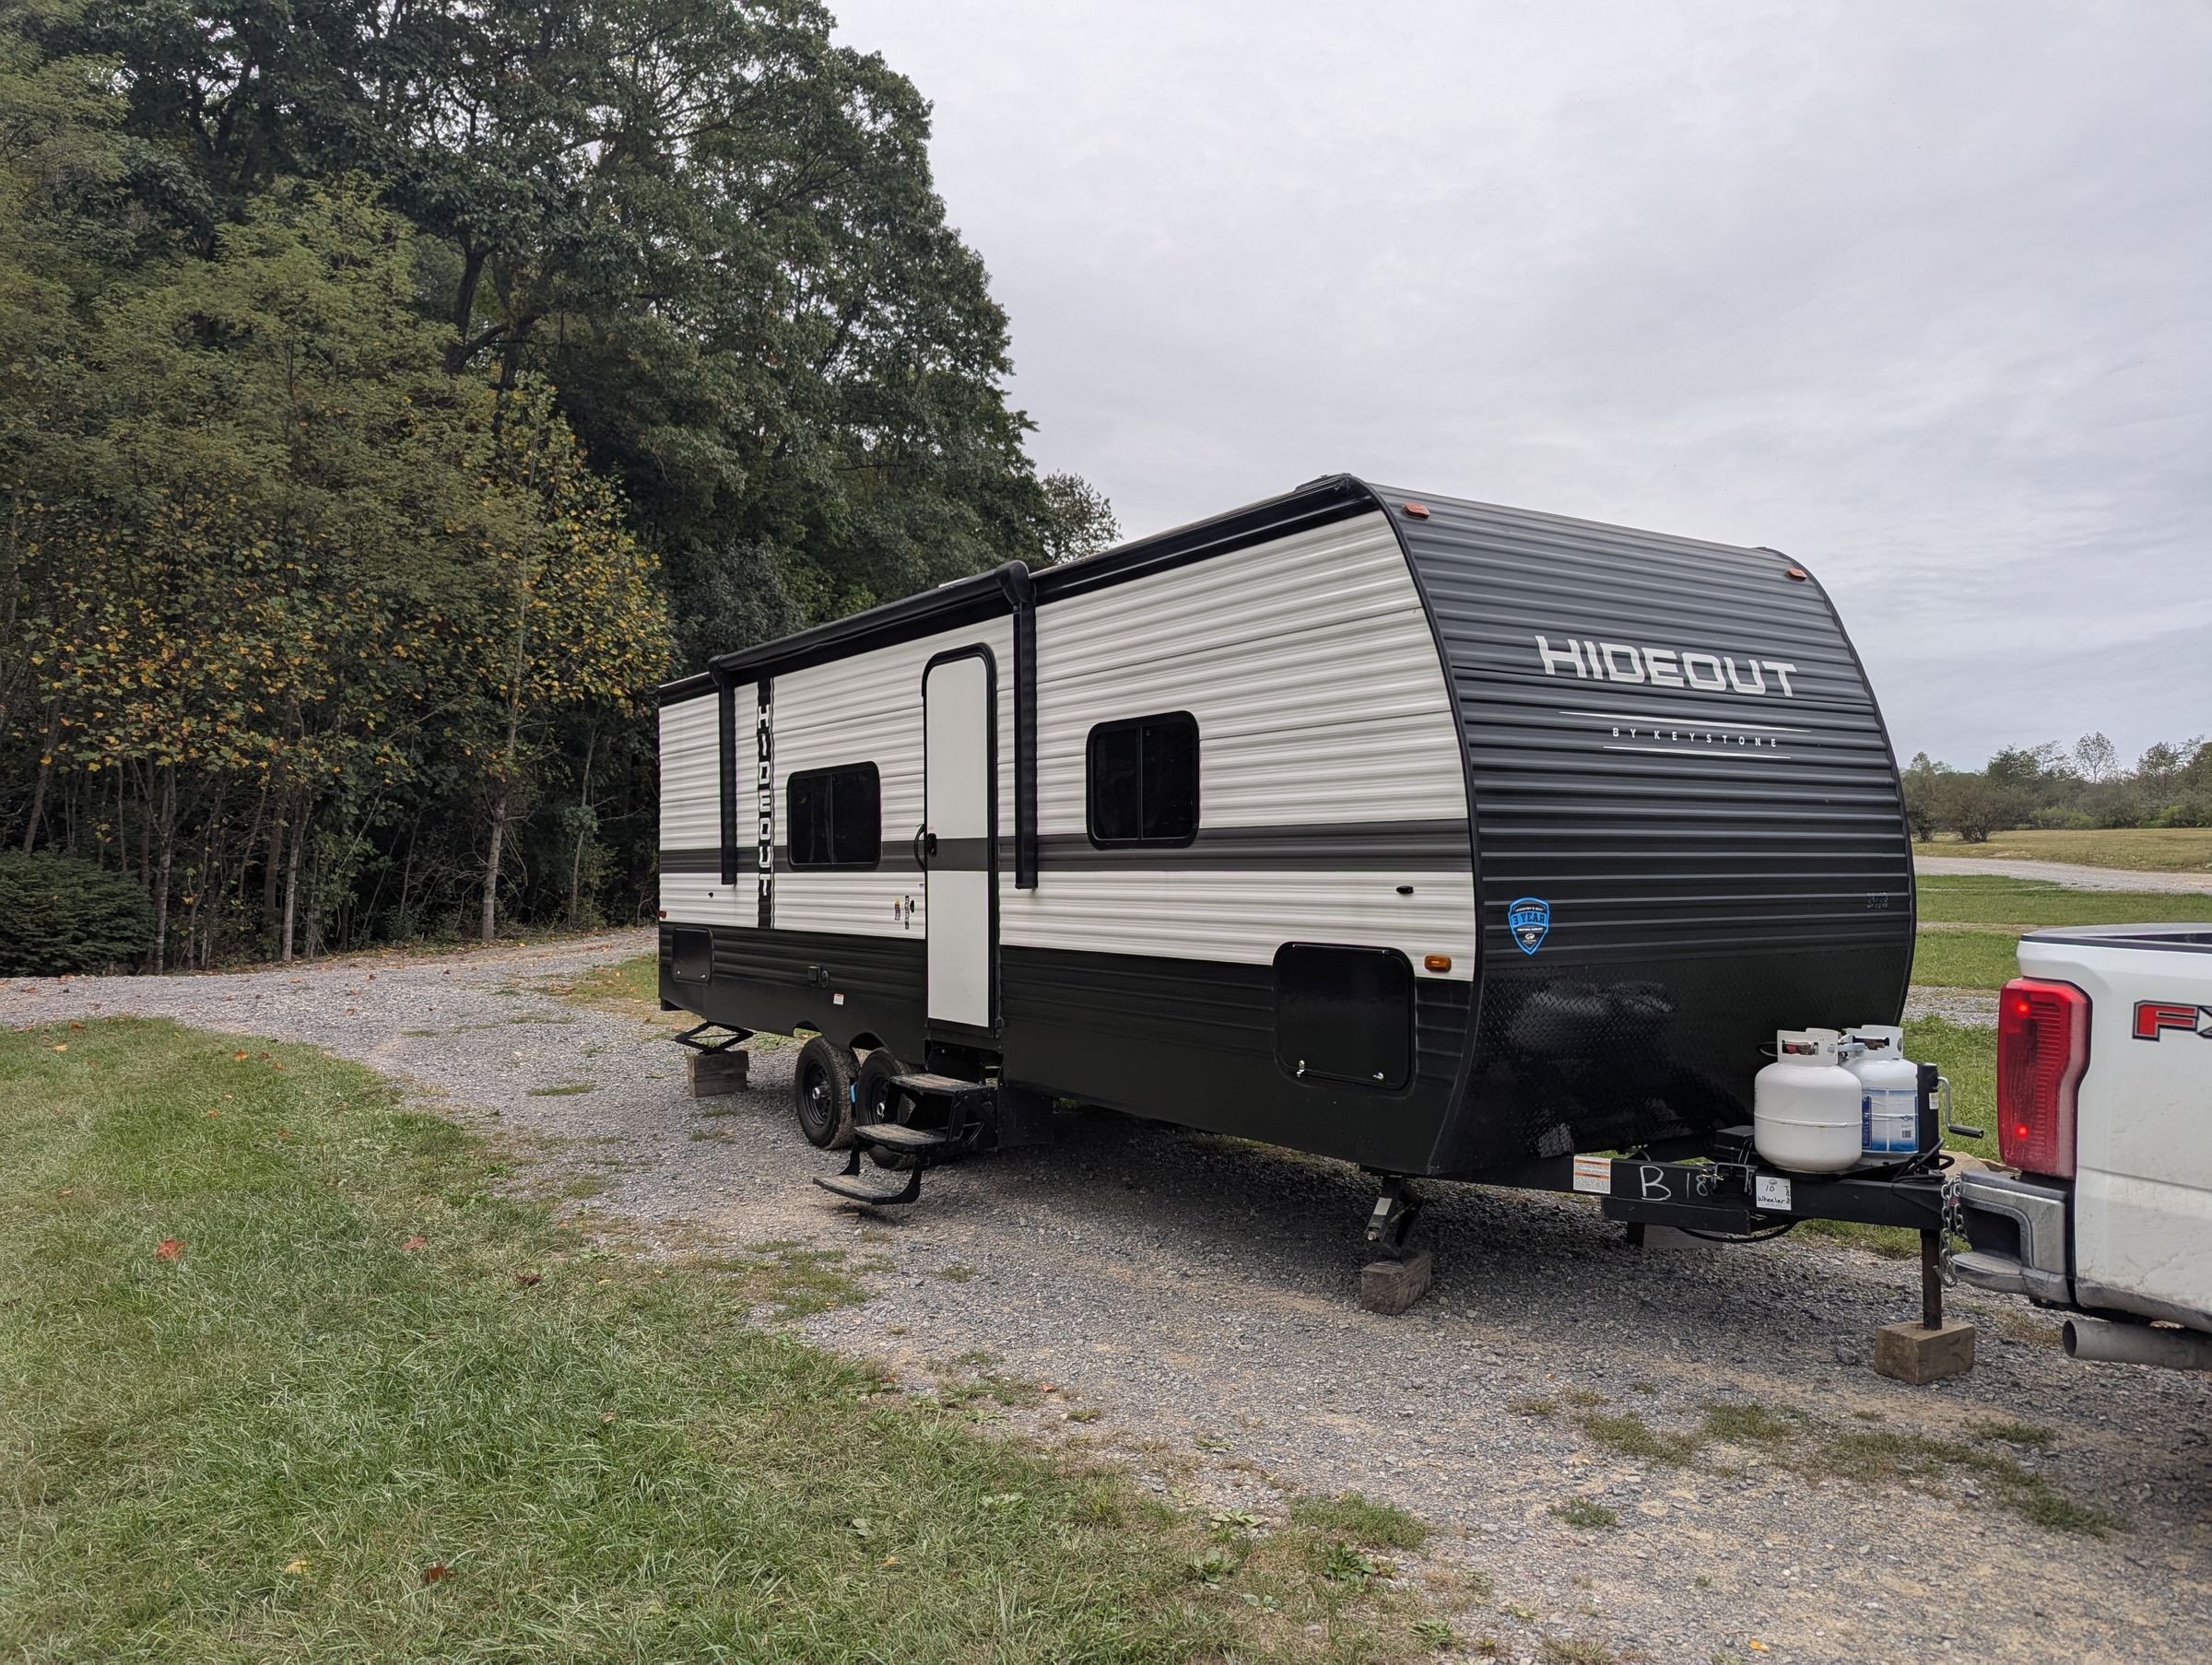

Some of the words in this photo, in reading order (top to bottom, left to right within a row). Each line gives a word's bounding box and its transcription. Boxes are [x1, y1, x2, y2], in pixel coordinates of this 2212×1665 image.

[1535, 635, 1797, 698] HIDEOUT
[1613, 727, 1637, 739] BY
[1653, 730, 1777, 747] KEYSTONE
[758, 704, 771, 897] HIDEOUT
[1512, 915, 1519, 926] 3
[1521, 912, 1546, 924] YEAR
[2132, 1000, 2212, 1042] F
[1640, 1166, 1672, 1202] B
[1758, 1196, 1785, 1204] Wheeler
